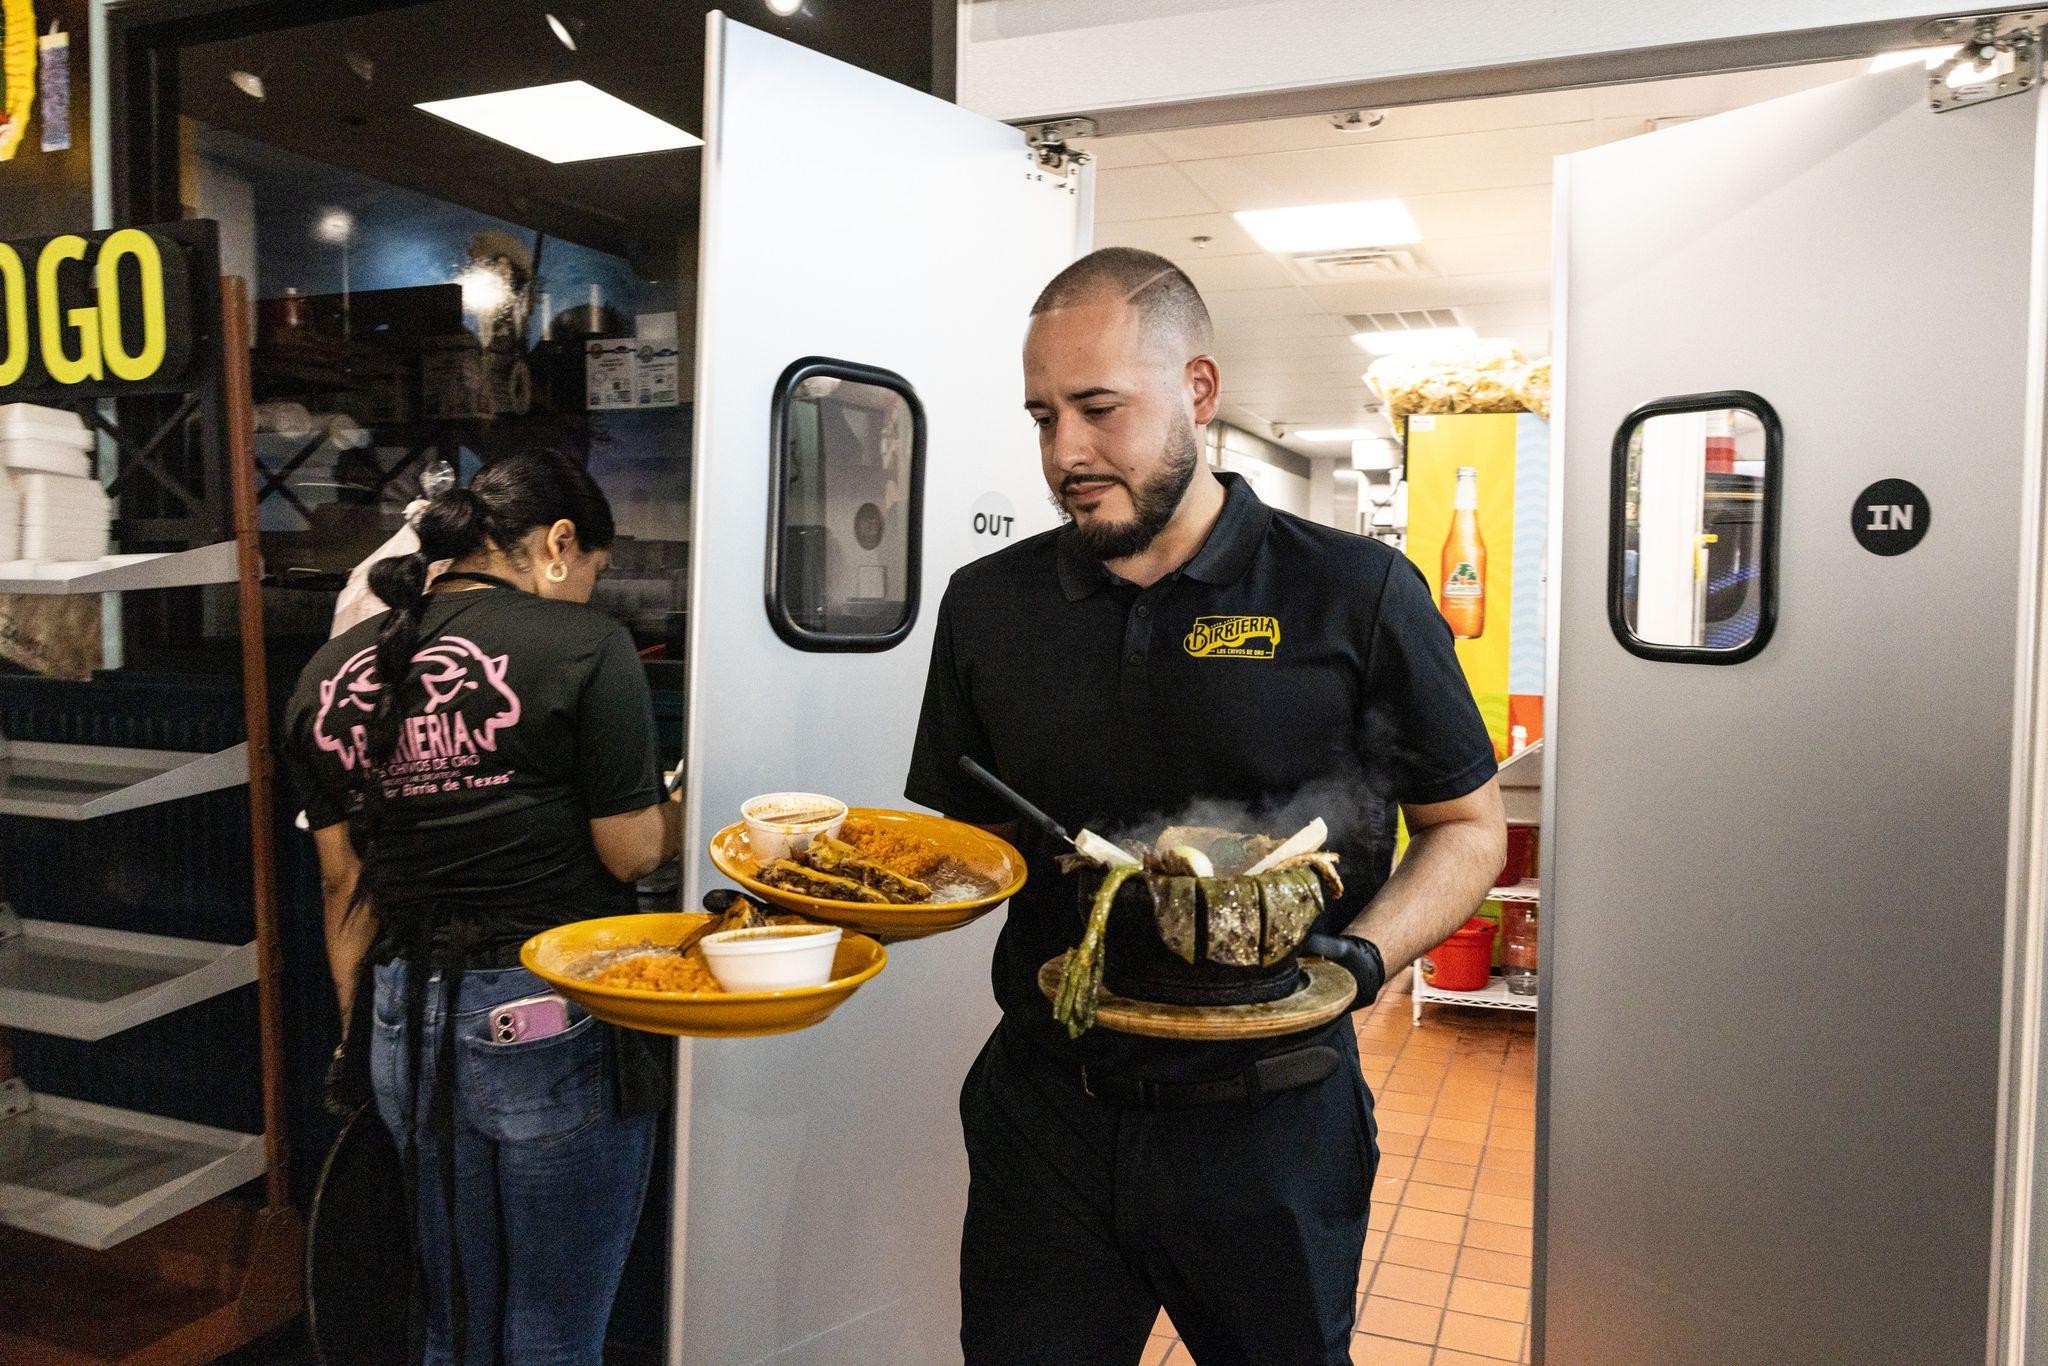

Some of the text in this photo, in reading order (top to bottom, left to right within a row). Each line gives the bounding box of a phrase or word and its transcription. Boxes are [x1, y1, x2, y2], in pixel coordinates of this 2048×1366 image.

[973, 512, 1015, 538] OUT
[1866, 504, 1914, 531] IN
[1184, 616, 1277, 653] BIRRIERIA
[1227, 648, 1247, 656] CHIVOS
[432, 757, 449, 771] DE
[451, 754, 481, 768] ORO
[402, 782, 438, 797] Birria
[441, 779, 460, 792] de
